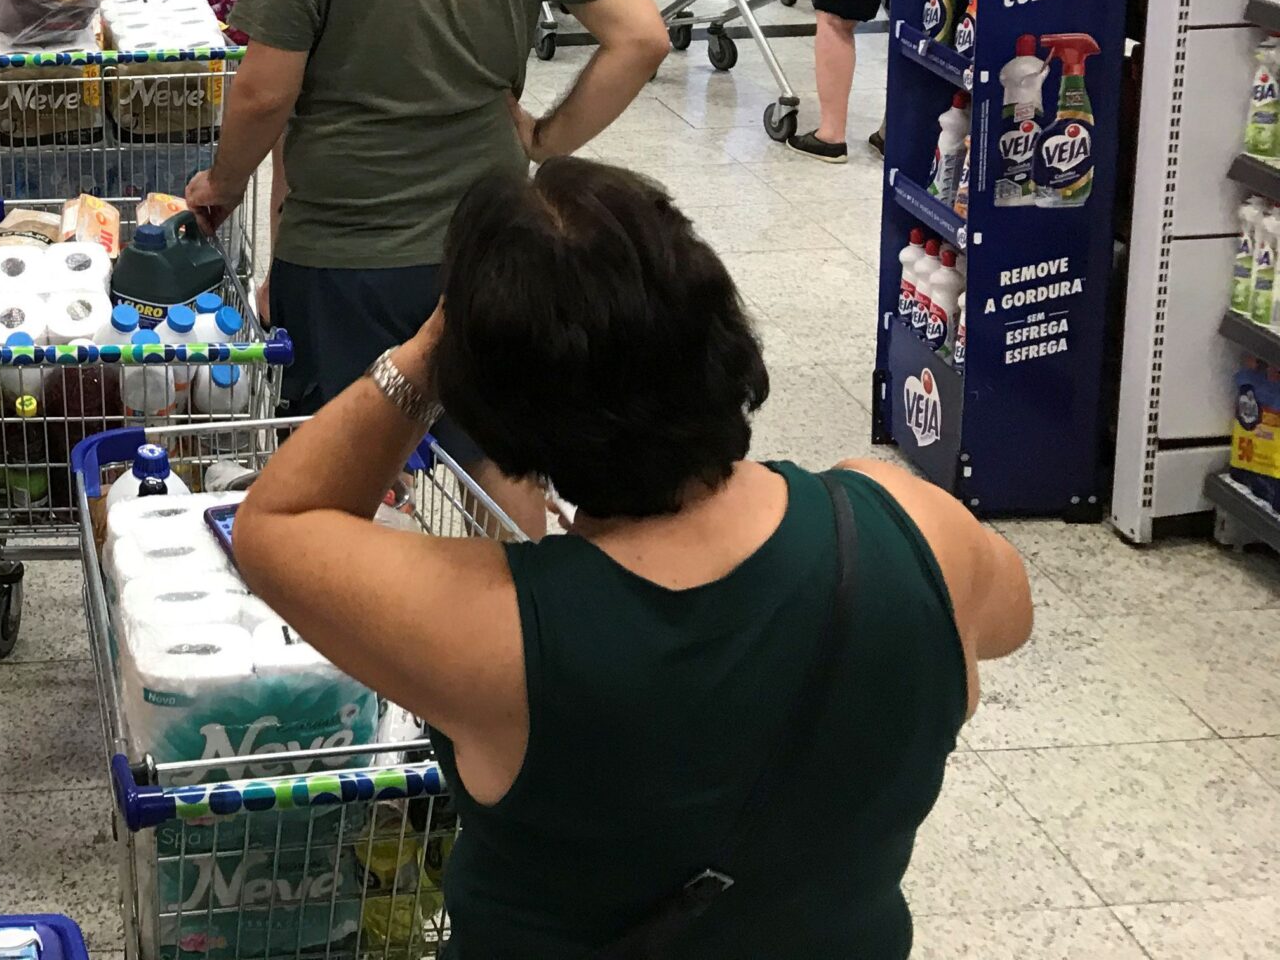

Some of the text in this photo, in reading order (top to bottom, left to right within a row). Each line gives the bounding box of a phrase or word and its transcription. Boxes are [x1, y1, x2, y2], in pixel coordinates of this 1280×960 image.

[1045, 137, 1089, 165] VEJA
[1000, 257, 1069, 287] REMOVE
[984, 278, 1083, 314] A GORDURA
[1006, 318, 1069, 345] ESFREGA
[1026, 312, 1046, 323] SEM
[1005, 338, 1068, 365] ESFREGA
[905, 388, 941, 438] VEJA
